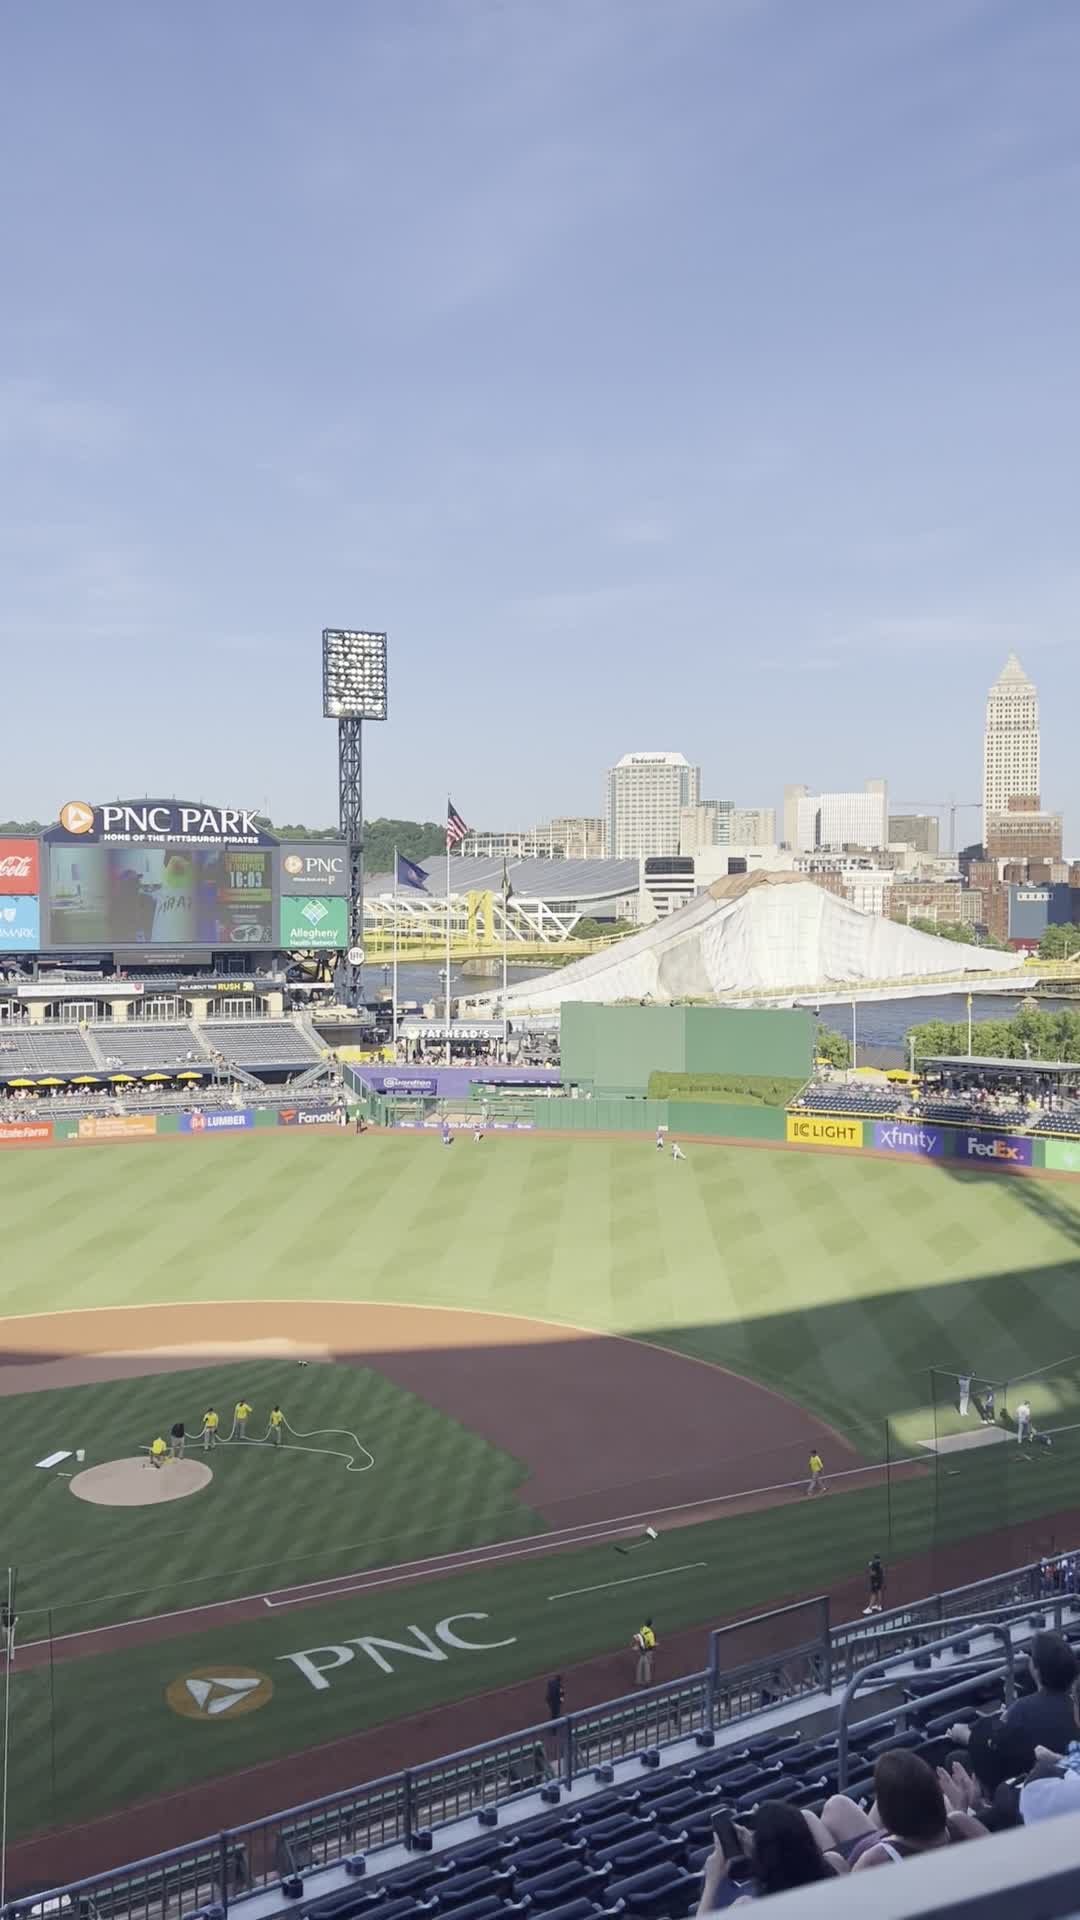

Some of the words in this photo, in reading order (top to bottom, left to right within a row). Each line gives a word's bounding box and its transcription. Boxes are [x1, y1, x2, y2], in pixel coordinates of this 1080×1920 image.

[100, 807, 170, 832] PNC
[179, 808, 260, 834] PARK
[104, 833, 131, 841] HOME
[147, 834, 165, 842] THE
[167, 835, 221, 843] PITTSBURGH
[223, 836, 259, 844] PIRATES
[304, 858, 343, 872] PNC
[290, 928, 338, 939] Allegheny
[218, 982, 241, 991] RUSH
[420, 1030, 440, 1038] FAT
[208, 1115, 246, 1127] LUMBER
[298, 1111, 339, 1124] Fanatic
[813, 1124, 856, 1140] LIGHT
[880, 1129, 936, 1151] xfinity
[967, 1137, 1018, 1160] FedEx
[274, 1612, 517, 1690] PNC
